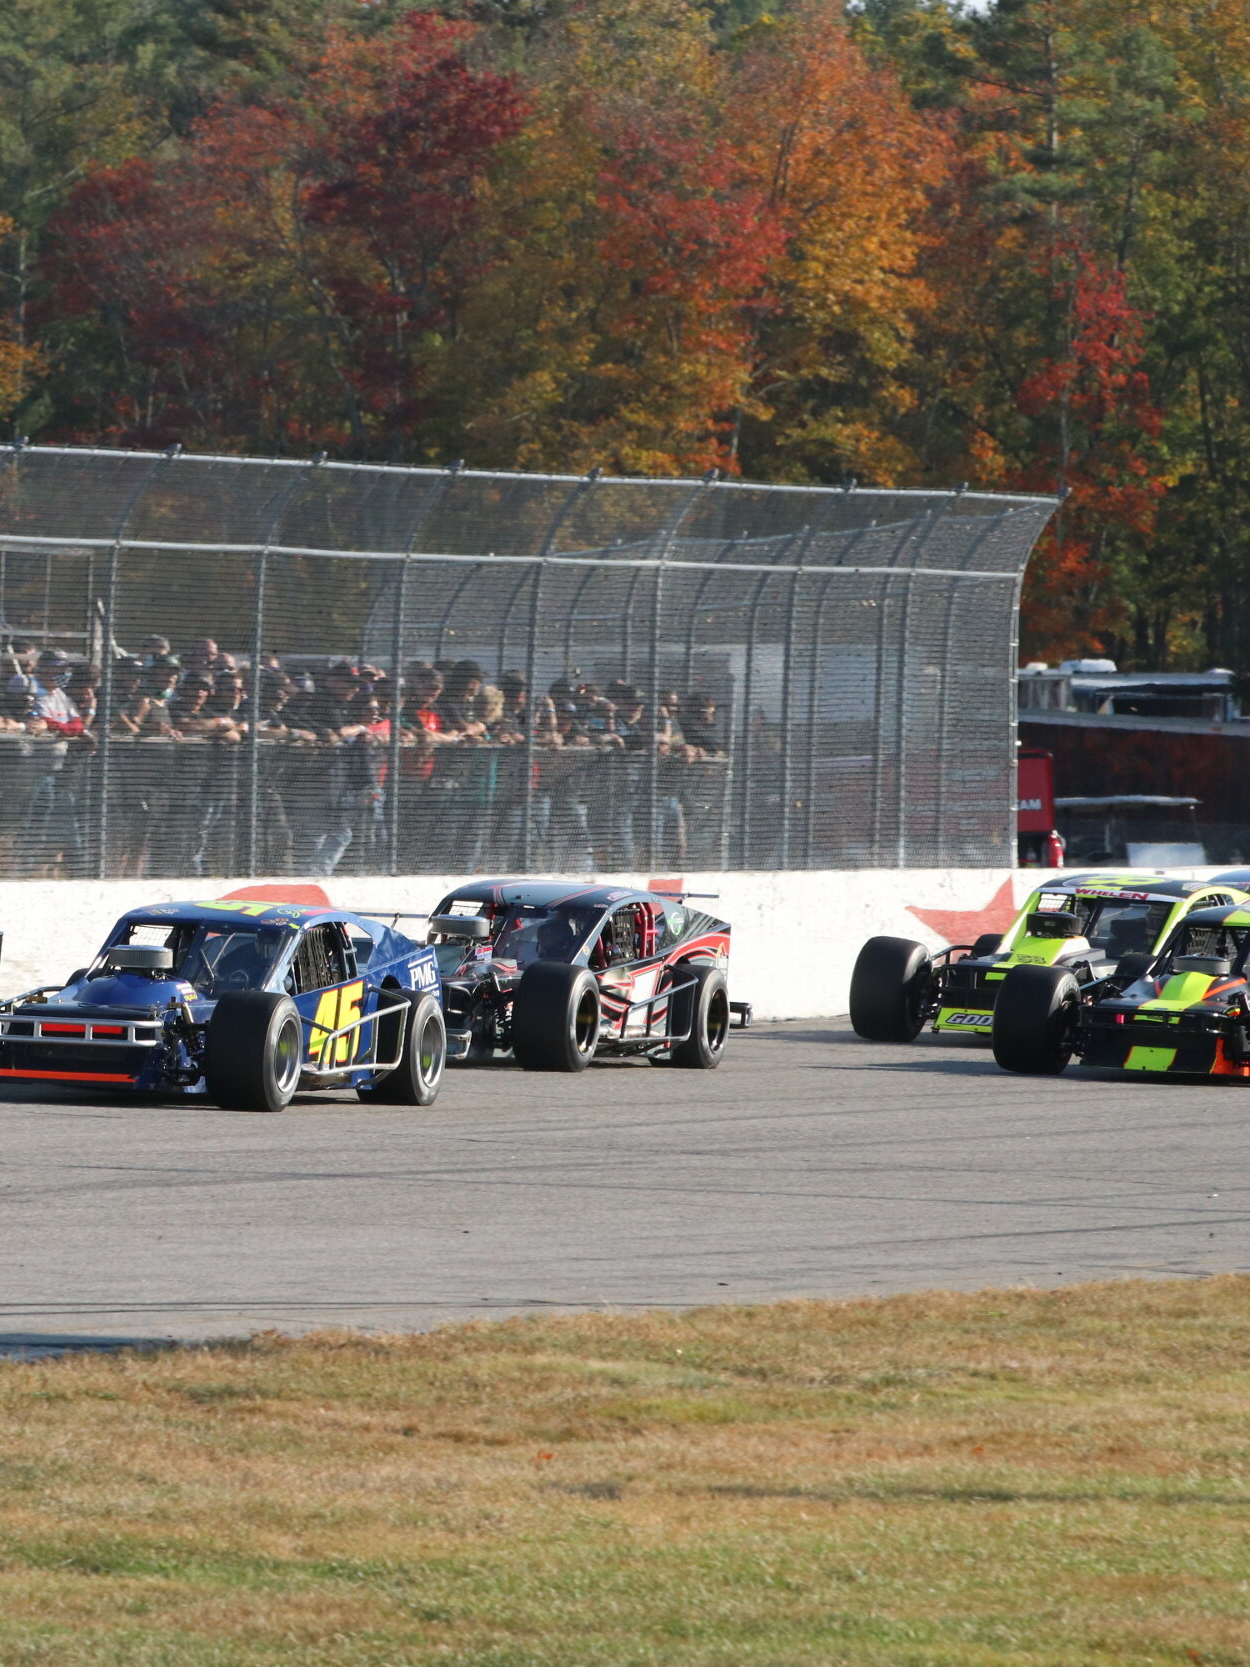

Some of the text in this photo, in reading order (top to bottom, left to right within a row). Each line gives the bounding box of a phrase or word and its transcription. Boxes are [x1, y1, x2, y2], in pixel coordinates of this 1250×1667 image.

[1075, 887, 1150, 901] WHELEN
[409, 961, 437, 991] PMG
[307, 980, 364, 1065] 45
